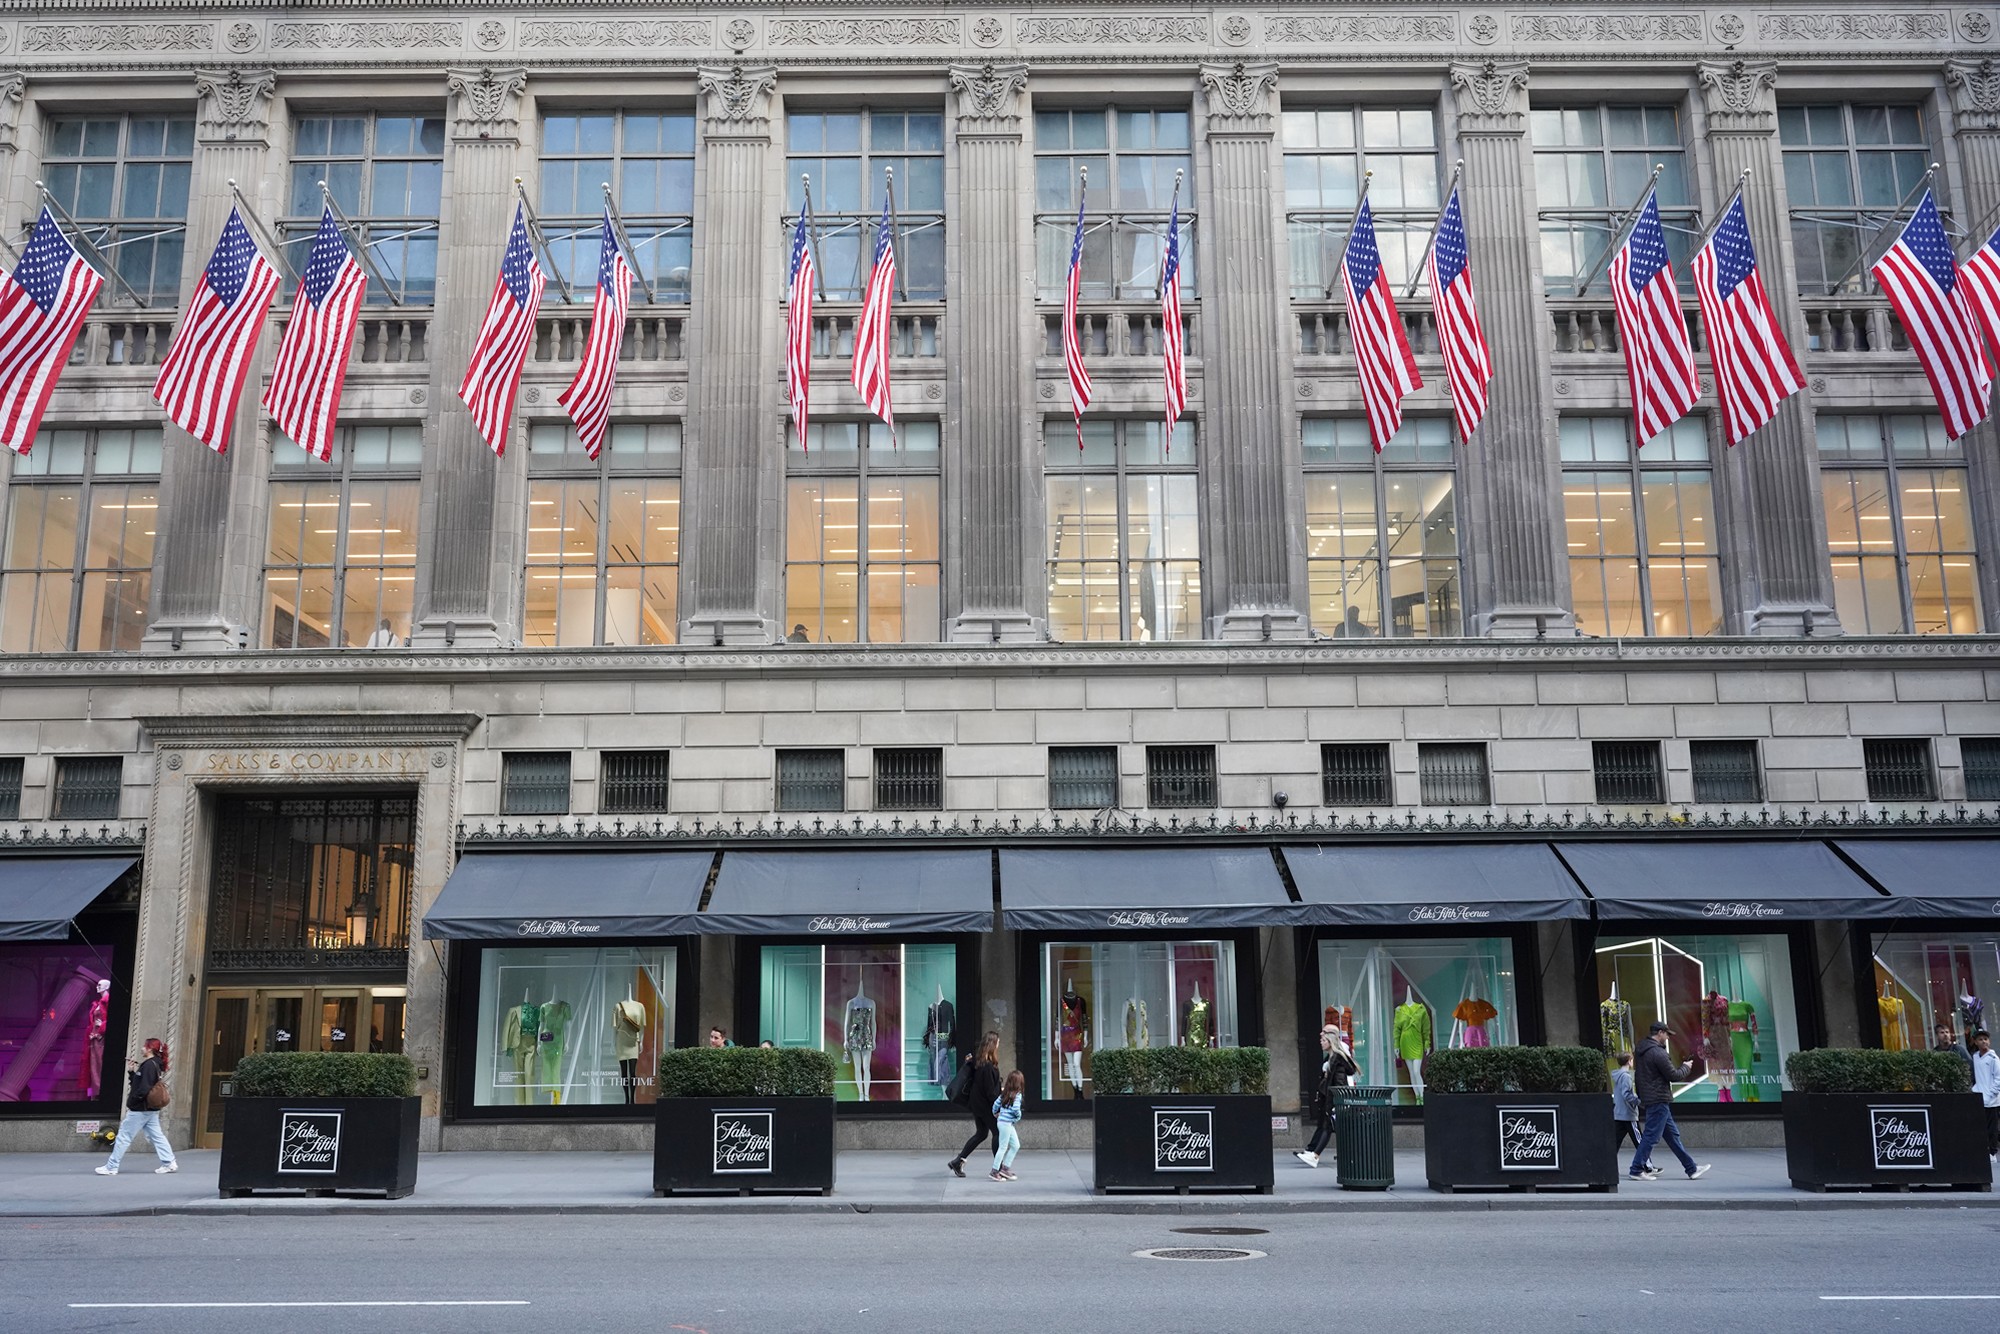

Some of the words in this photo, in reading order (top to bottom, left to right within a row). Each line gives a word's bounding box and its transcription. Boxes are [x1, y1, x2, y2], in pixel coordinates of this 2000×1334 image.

[208, 753, 260, 769] SAKS
[269, 753, 281, 769] &
[291, 752, 411, 770] COMPANY
[1107, 912, 1134, 926] Saks
[1131, 912, 1155, 926] Fifth
[1150, 911, 1189, 925] Avenue
[1408, 906, 1435, 921] Saks
[1432, 906, 1456, 920] Fifth
[1451, 905, 1490, 920] Avenue
[1702, 903, 1729, 917] Saks
[1726, 903, 1750, 917] Fifth
[1745, 903, 1783, 917] Avenue
[518, 920, 544, 935] Saks
[541, 920, 566, 935] Fifth
[561, 920, 600, 934] Avenue
[808, 917, 835, 932] Saks
[832, 917, 856, 931] Fifth
[851, 917, 890, 931] Avenue
[311, 953, 319, 963] 3
[610, 1077, 629, 1087] THE
[631, 1077, 655, 1086] TIME
[1740, 1074, 1759, 1084] THE
[283, 1121, 319, 1141] Saks
[716, 1121, 751, 1142] Saks
[1157, 1118, 1191, 1139] Saks
[1502, 1117, 1536, 1138] Saks
[1874, 1117, 1909, 1138] Saks
[282, 1144, 331, 1164] Avenue
[716, 1144, 765, 1164] Avenue
[1158, 1141, 1206, 1162] Avenue
[1503, 1140, 1551, 1160] Avenue
[1876, 1140, 1925, 1160] Avenue
